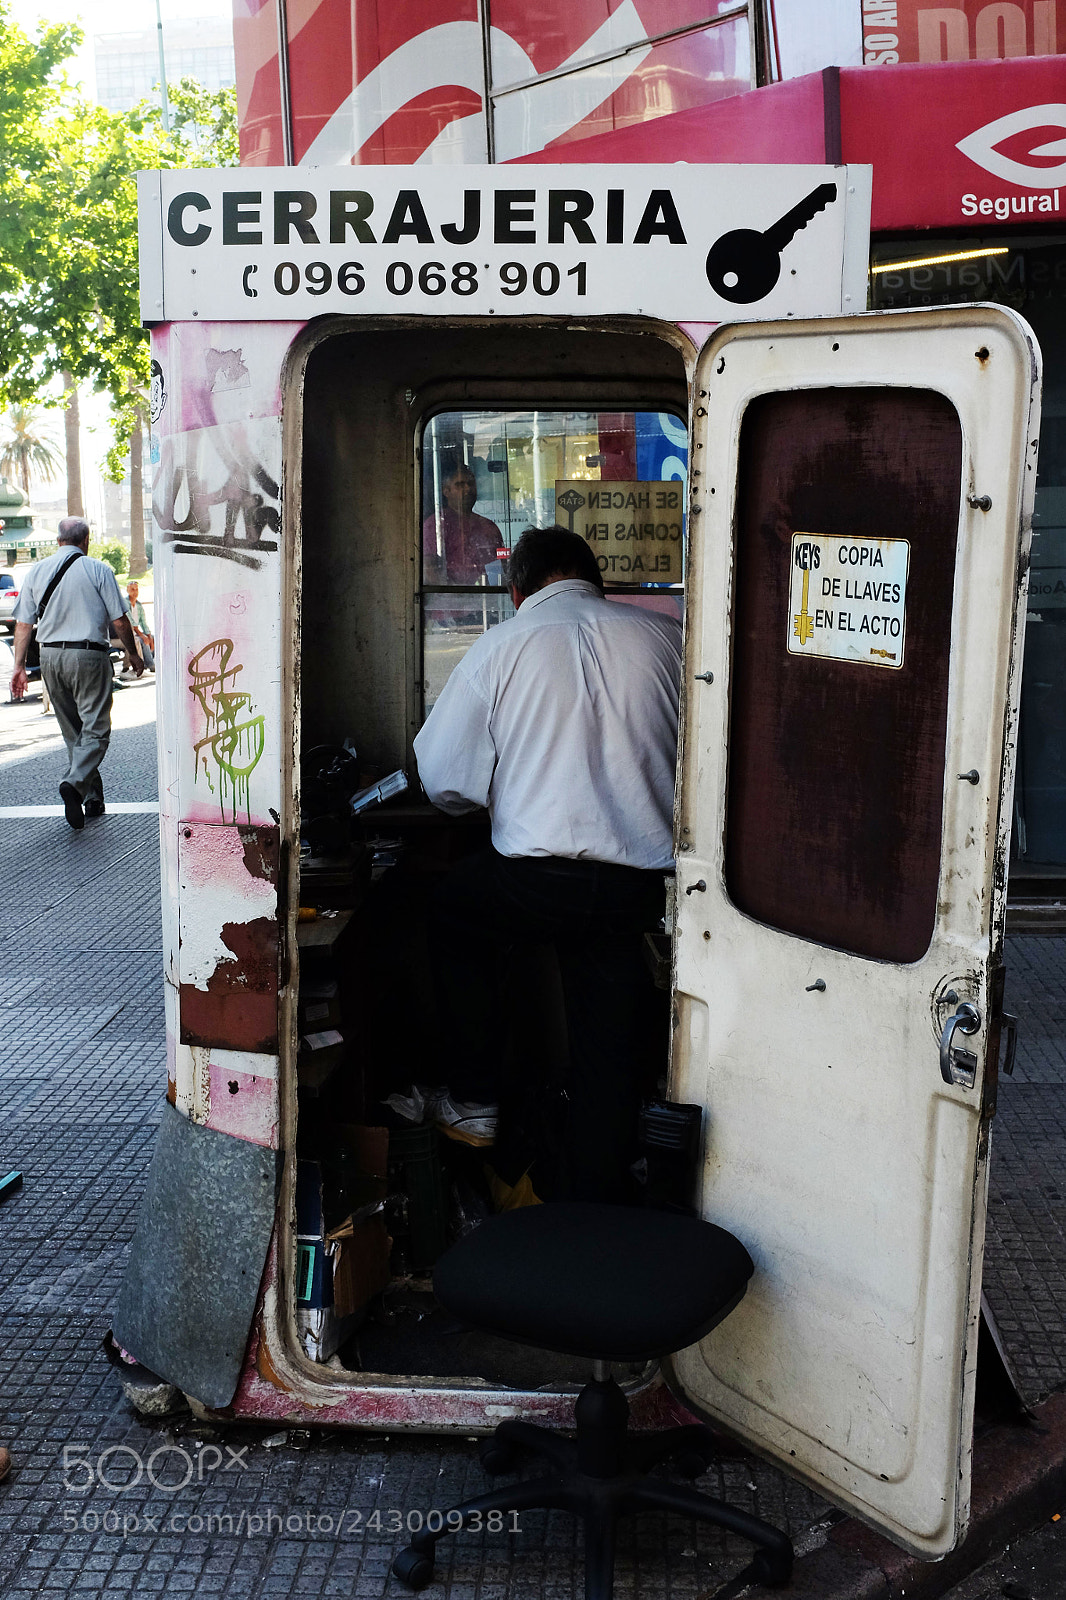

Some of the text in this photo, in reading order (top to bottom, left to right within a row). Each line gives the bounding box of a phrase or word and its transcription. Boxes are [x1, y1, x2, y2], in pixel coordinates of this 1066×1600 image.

[168, 190, 688, 246] CERRAJERIA
[961, 189, 1060, 220] Segural
[274, 261, 587, 297] 096 068 901
[795, 543, 820, 570] KEYS
[838, 545, 883, 567] COPIA
[822, 577, 901, 603] DE LLAVES
[815, 609, 901, 637] EN EL ACTO
